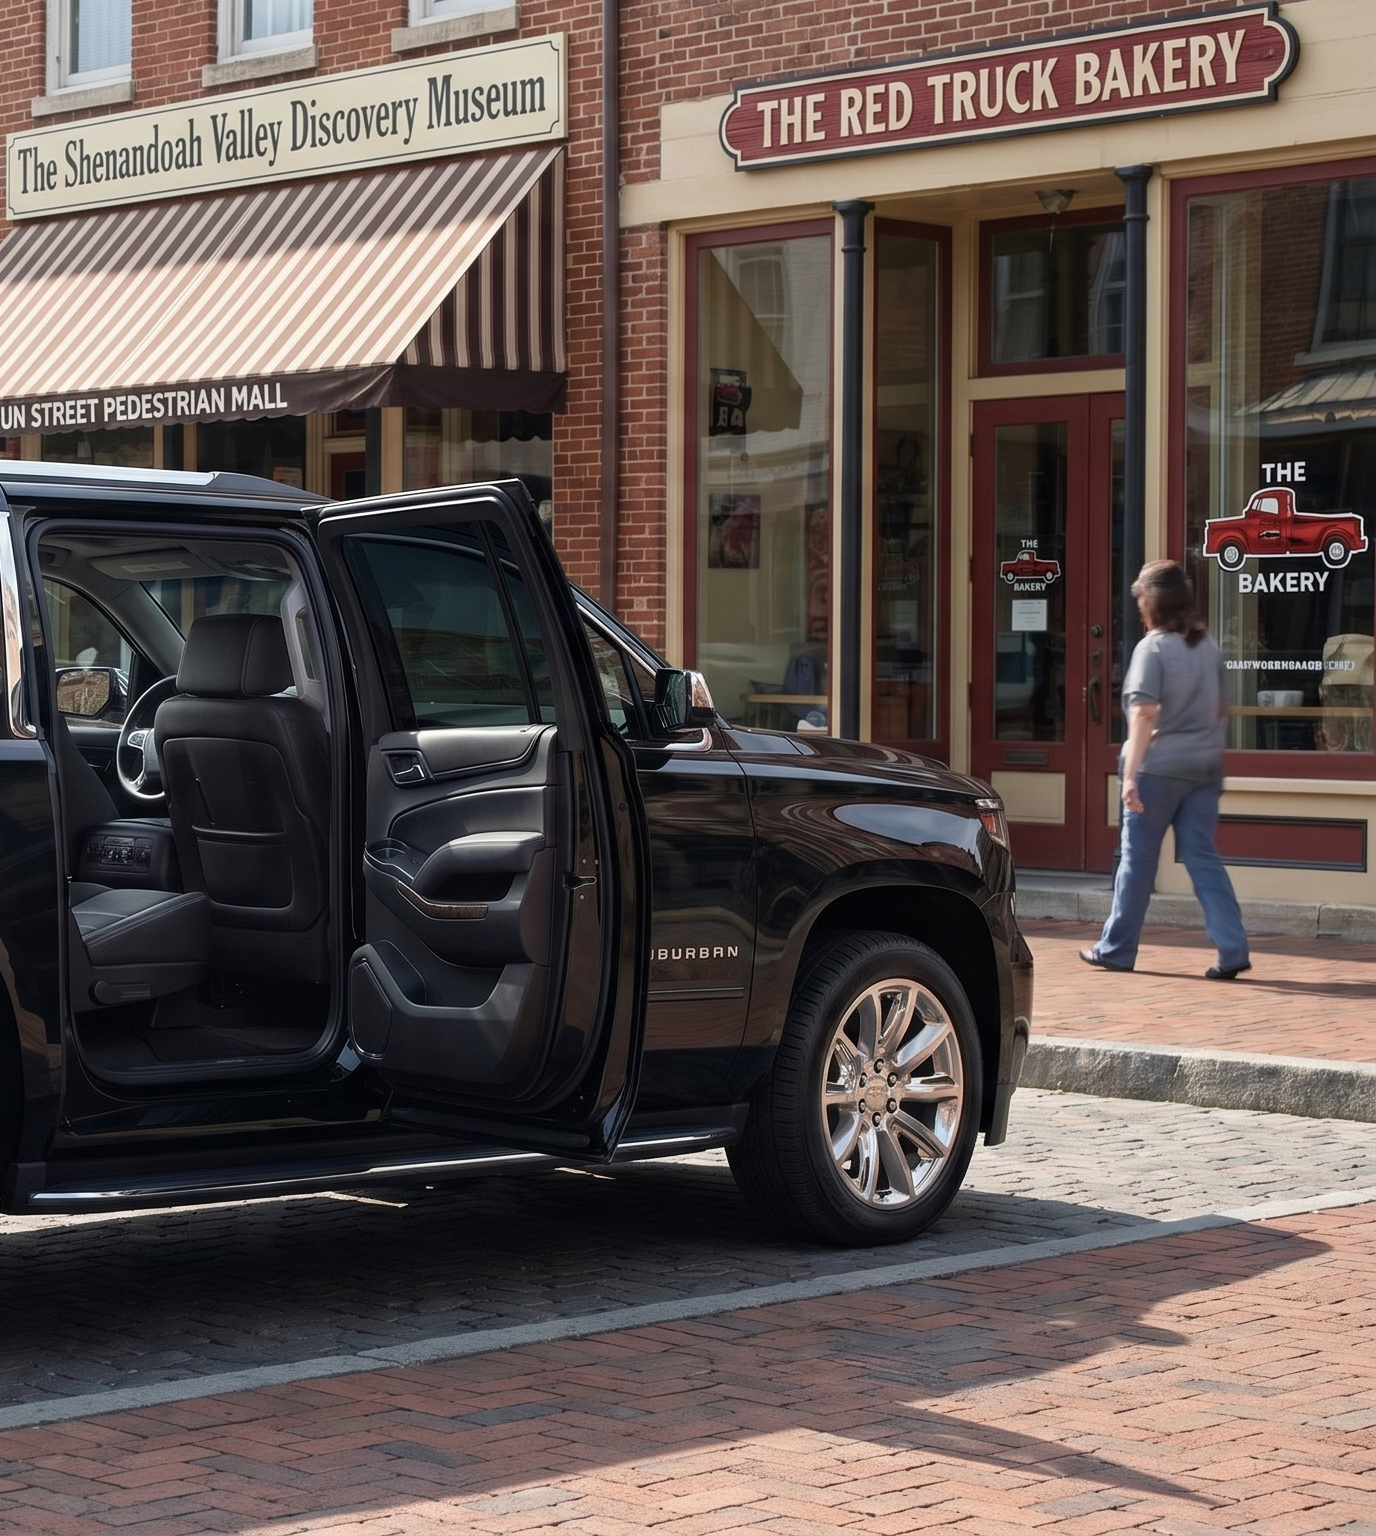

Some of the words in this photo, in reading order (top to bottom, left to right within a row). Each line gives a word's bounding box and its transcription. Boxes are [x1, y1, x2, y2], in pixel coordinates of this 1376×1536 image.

[757, 92, 825, 148] THE
[840, 81, 913, 138] RED
[927, 57, 1059, 125] TRUCK
[1075, 29, 1246, 106] BAKERY
[18, 147, 57, 194] The
[64, 119, 203, 188] Shenandoah
[210, 107, 283, 167] Valley
[290, 98, 418, 152] Discovery
[427, 74, 546, 130] Museum
[31, 398, 99, 428] STREET
[103, 387, 226, 423] PEDESTRIAN
[231, 382, 288, 412] MALL
[1261, 461, 1306, 483] THE
[1020, 539, 1039, 549] THE
[1238, 571, 1330, 594] BAKERY
